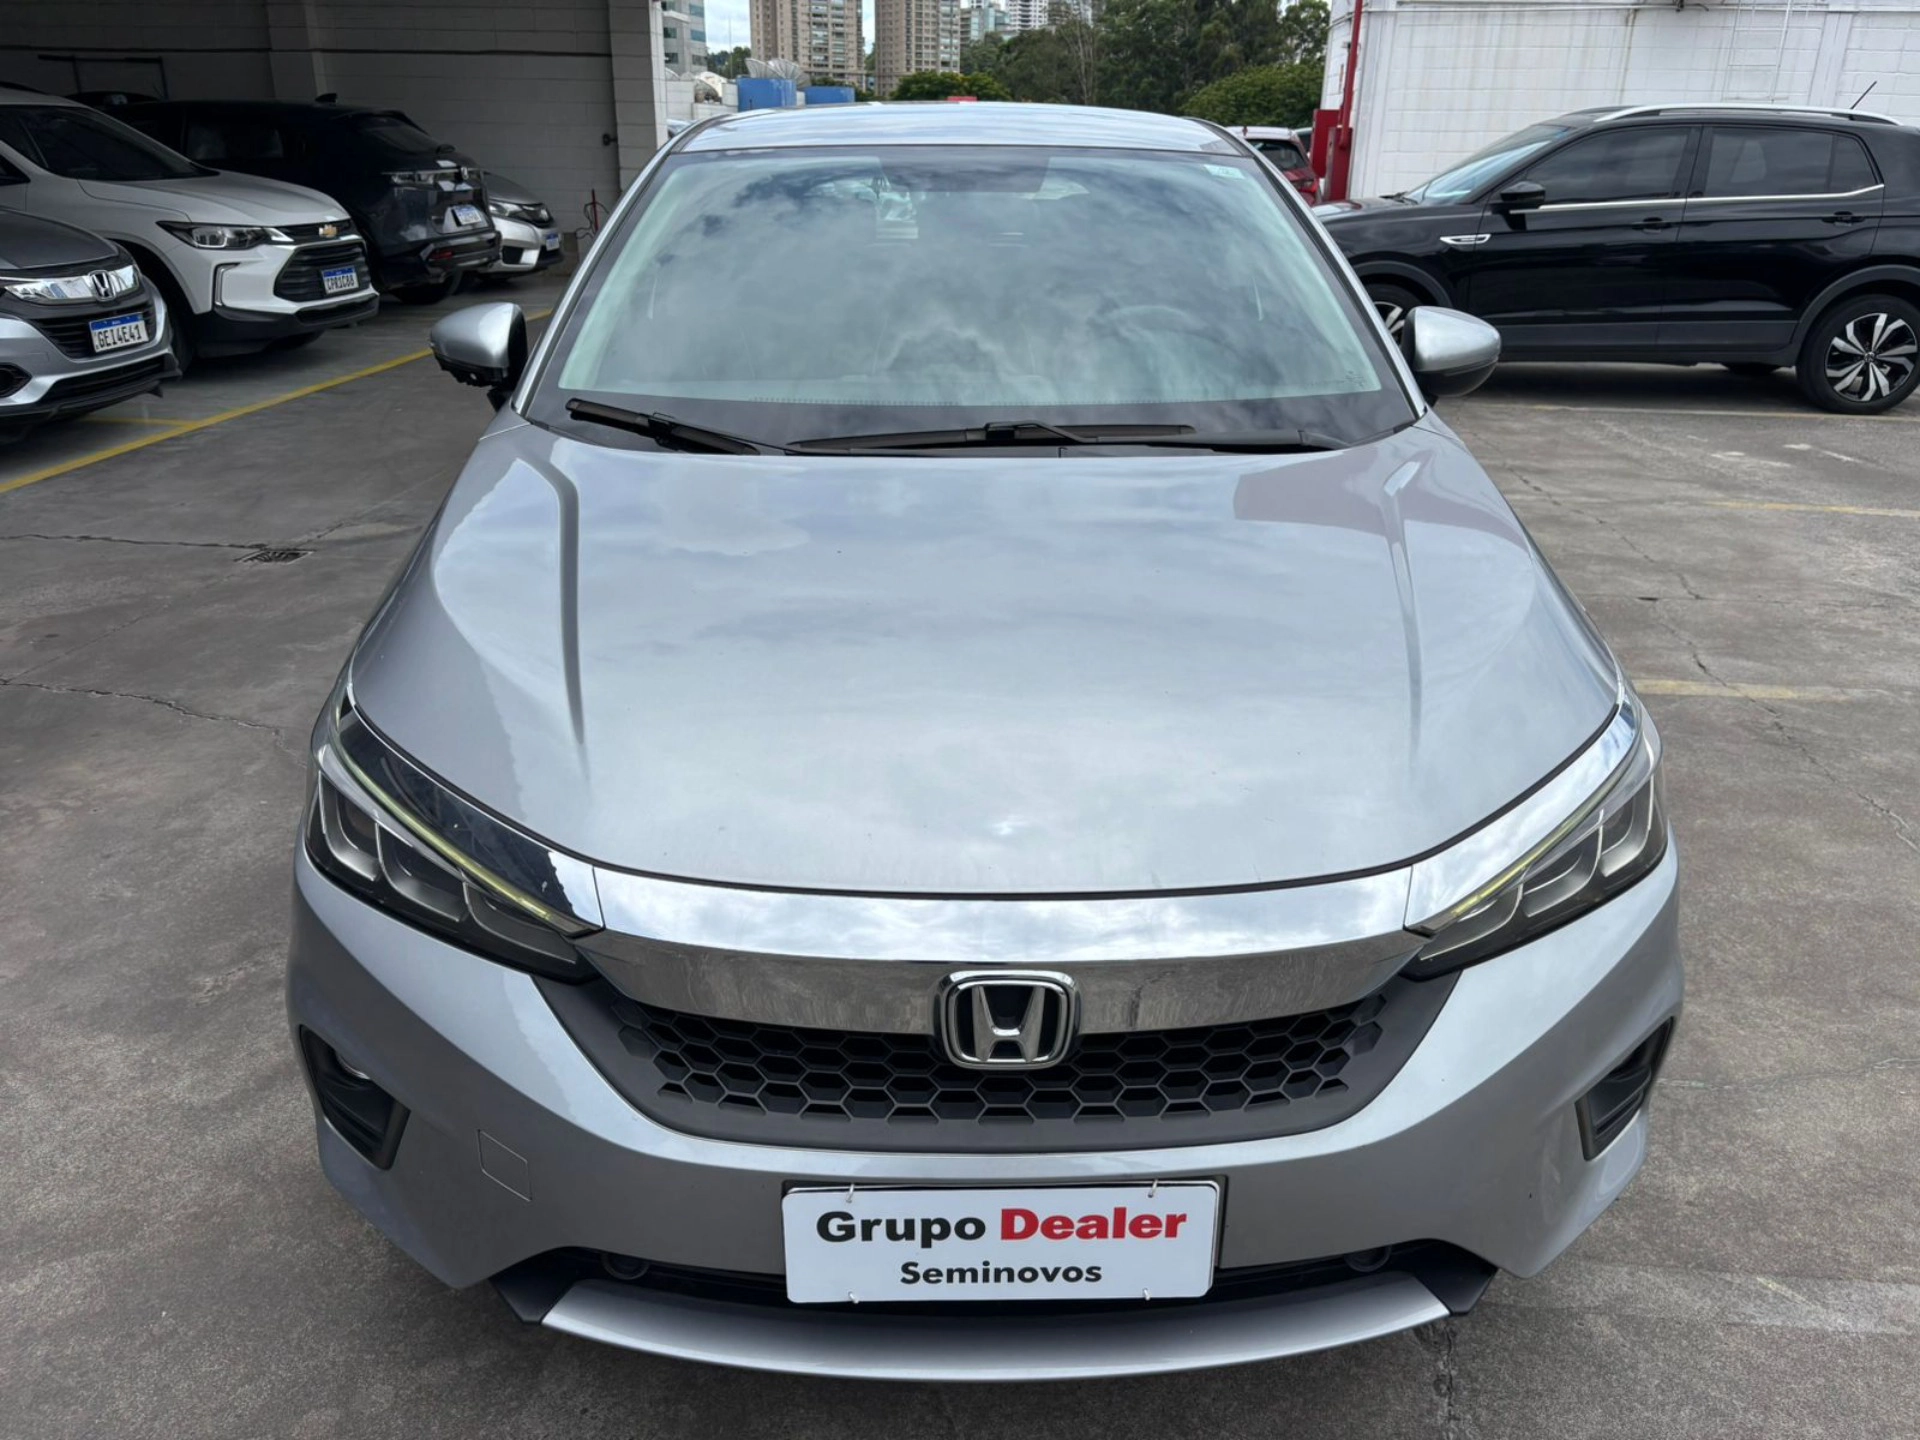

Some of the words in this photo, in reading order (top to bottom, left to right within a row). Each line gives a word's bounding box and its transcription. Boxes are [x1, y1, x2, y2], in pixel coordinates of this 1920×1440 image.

[97, 324, 142, 348] GEI4E41
[816, 1211, 986, 1249] Grupo
[1001, 1207, 1188, 1241] Dealer
[900, 1260, 1102, 1285] Seminovos
